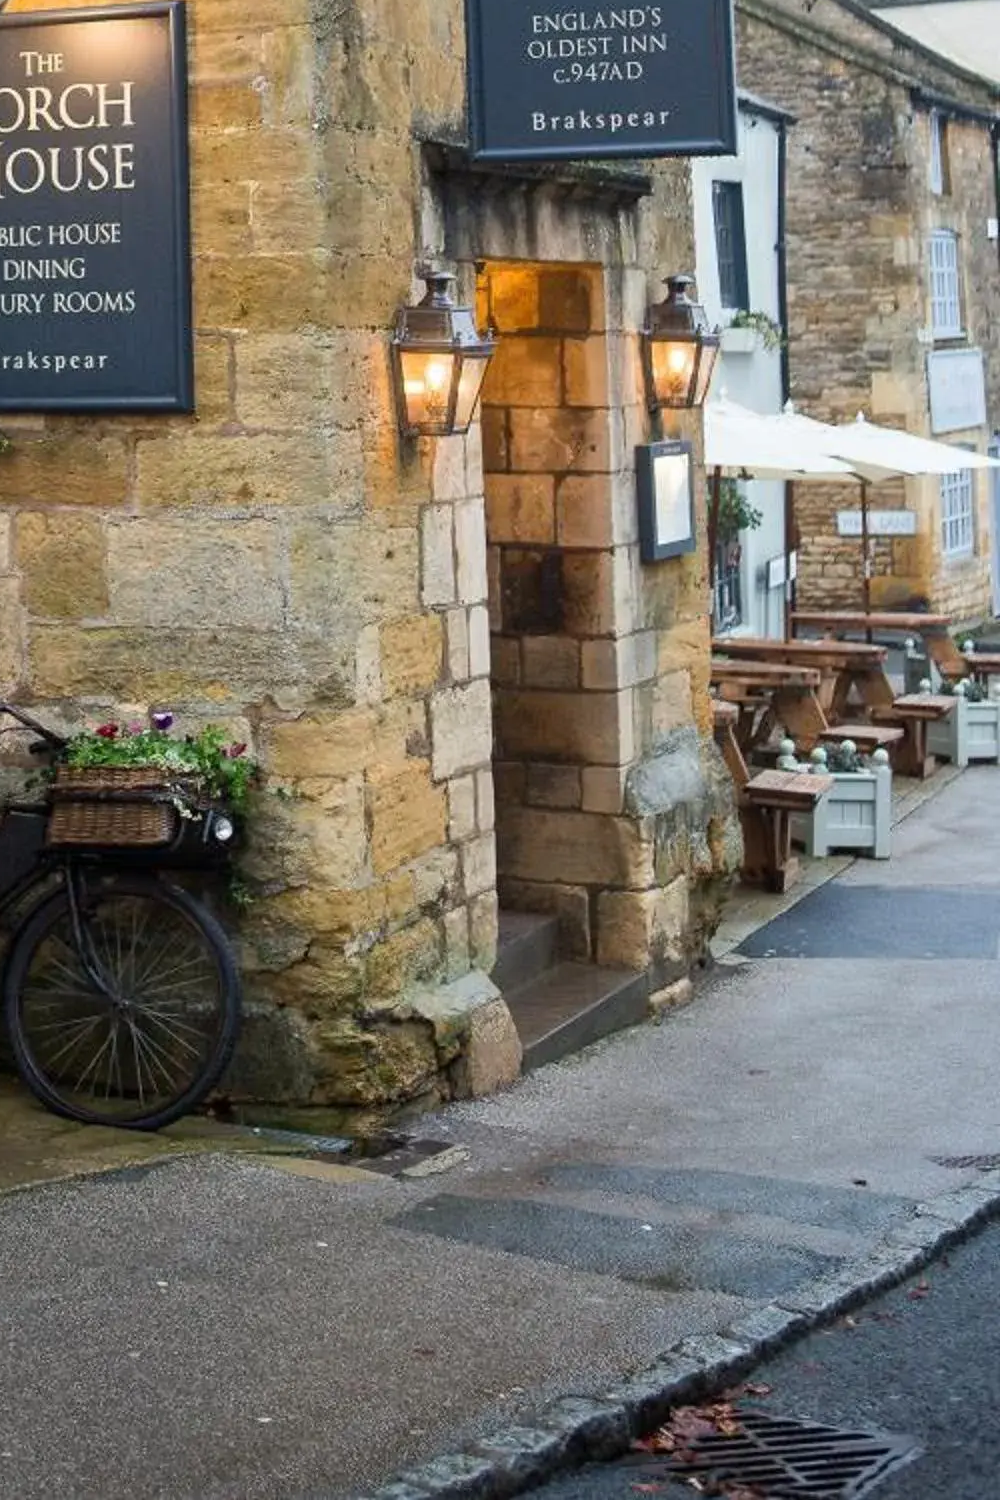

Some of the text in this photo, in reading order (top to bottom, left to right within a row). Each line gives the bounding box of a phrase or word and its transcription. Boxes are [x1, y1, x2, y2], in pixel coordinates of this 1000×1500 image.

[532, 7, 661, 34] ENGLAND'S
[527, 34, 667, 59] OLDEST INN
[19, 51, 64, 76] THE
[531, 109, 670, 134] Brakspear
[48, 223, 121, 245] HOUSE
[3, 258, 86, 281] DINING
[52, 291, 136, 313] ROOMS
